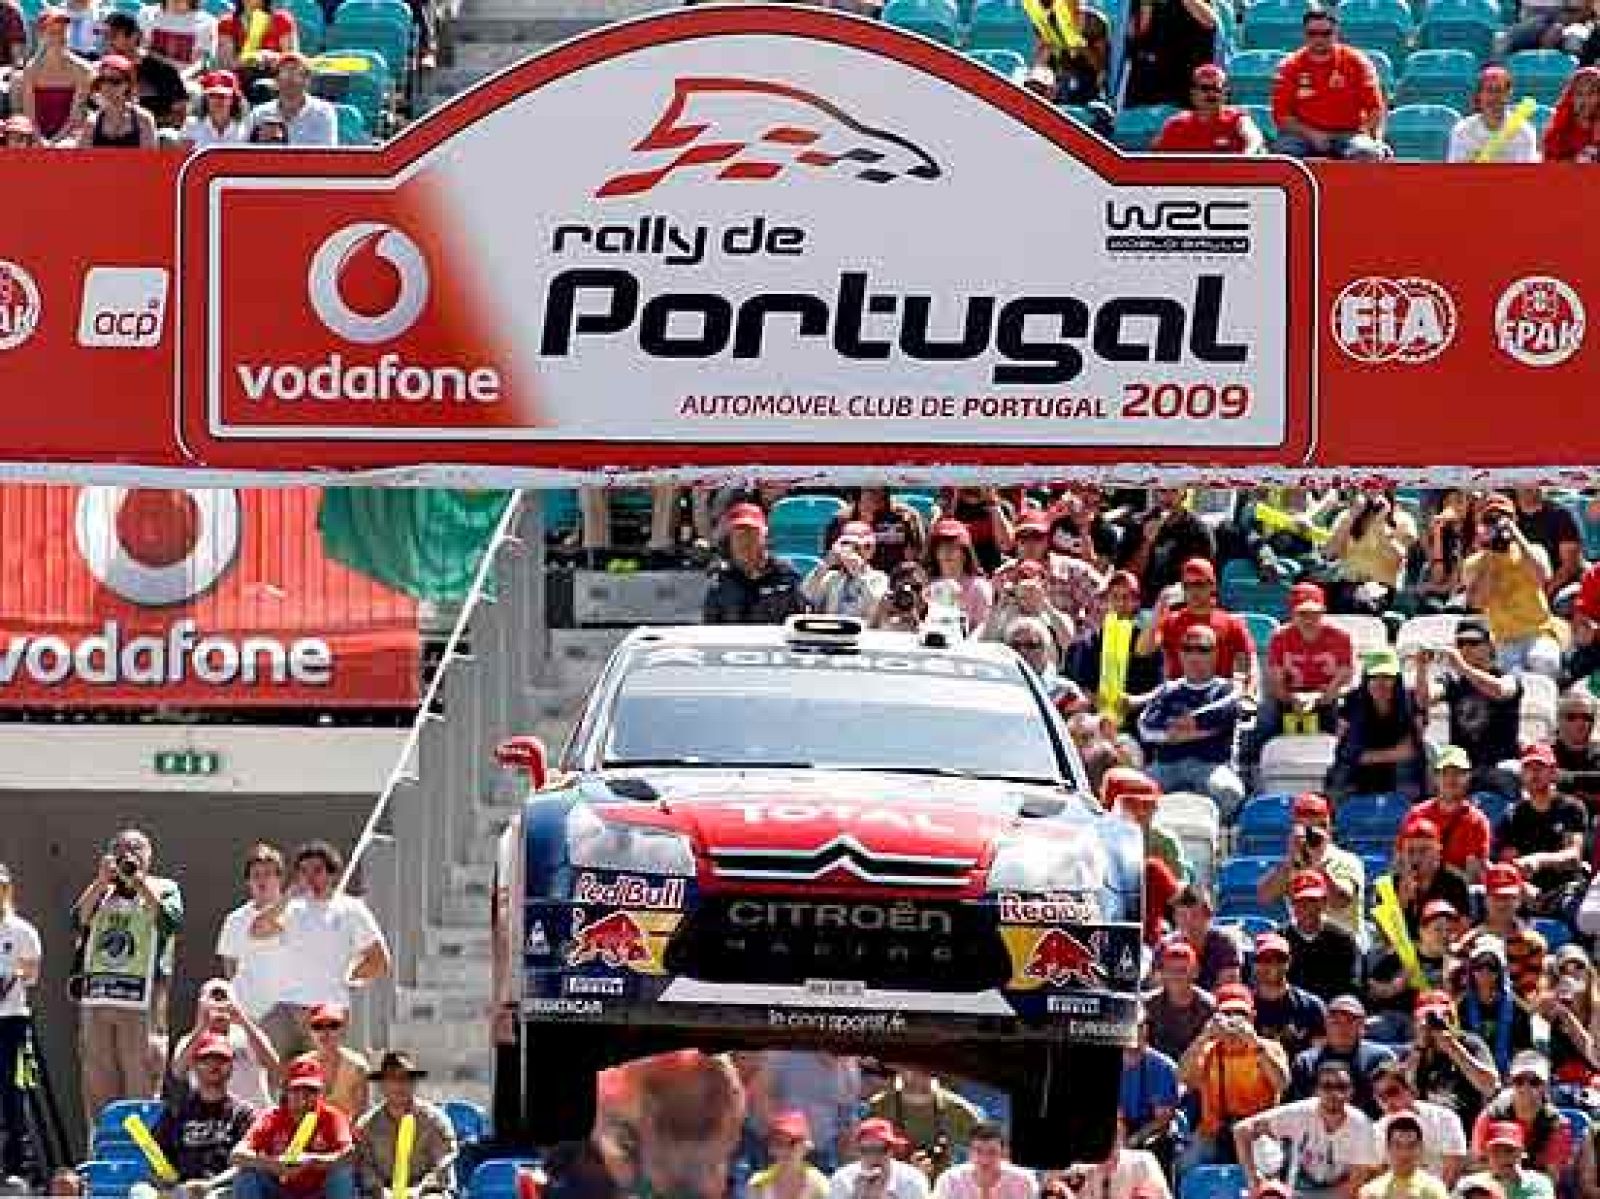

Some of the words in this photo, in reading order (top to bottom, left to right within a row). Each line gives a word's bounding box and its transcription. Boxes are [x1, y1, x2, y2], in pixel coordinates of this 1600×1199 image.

[1106, 200, 1250, 231] WRC
[553, 216, 706, 265] rally
[723, 217, 805, 255] de
[95, 312, 158, 341] acp
[541, 268, 1249, 385] Portugal
[238, 355, 500, 402] vodafone
[847, 397, 913, 418] CLUB
[920, 397, 956, 418] DE
[961, 397, 1106, 419] PORTUGAL
[1120, 384, 1250, 420] 2009
[0, 620, 333, 685] vodafone
